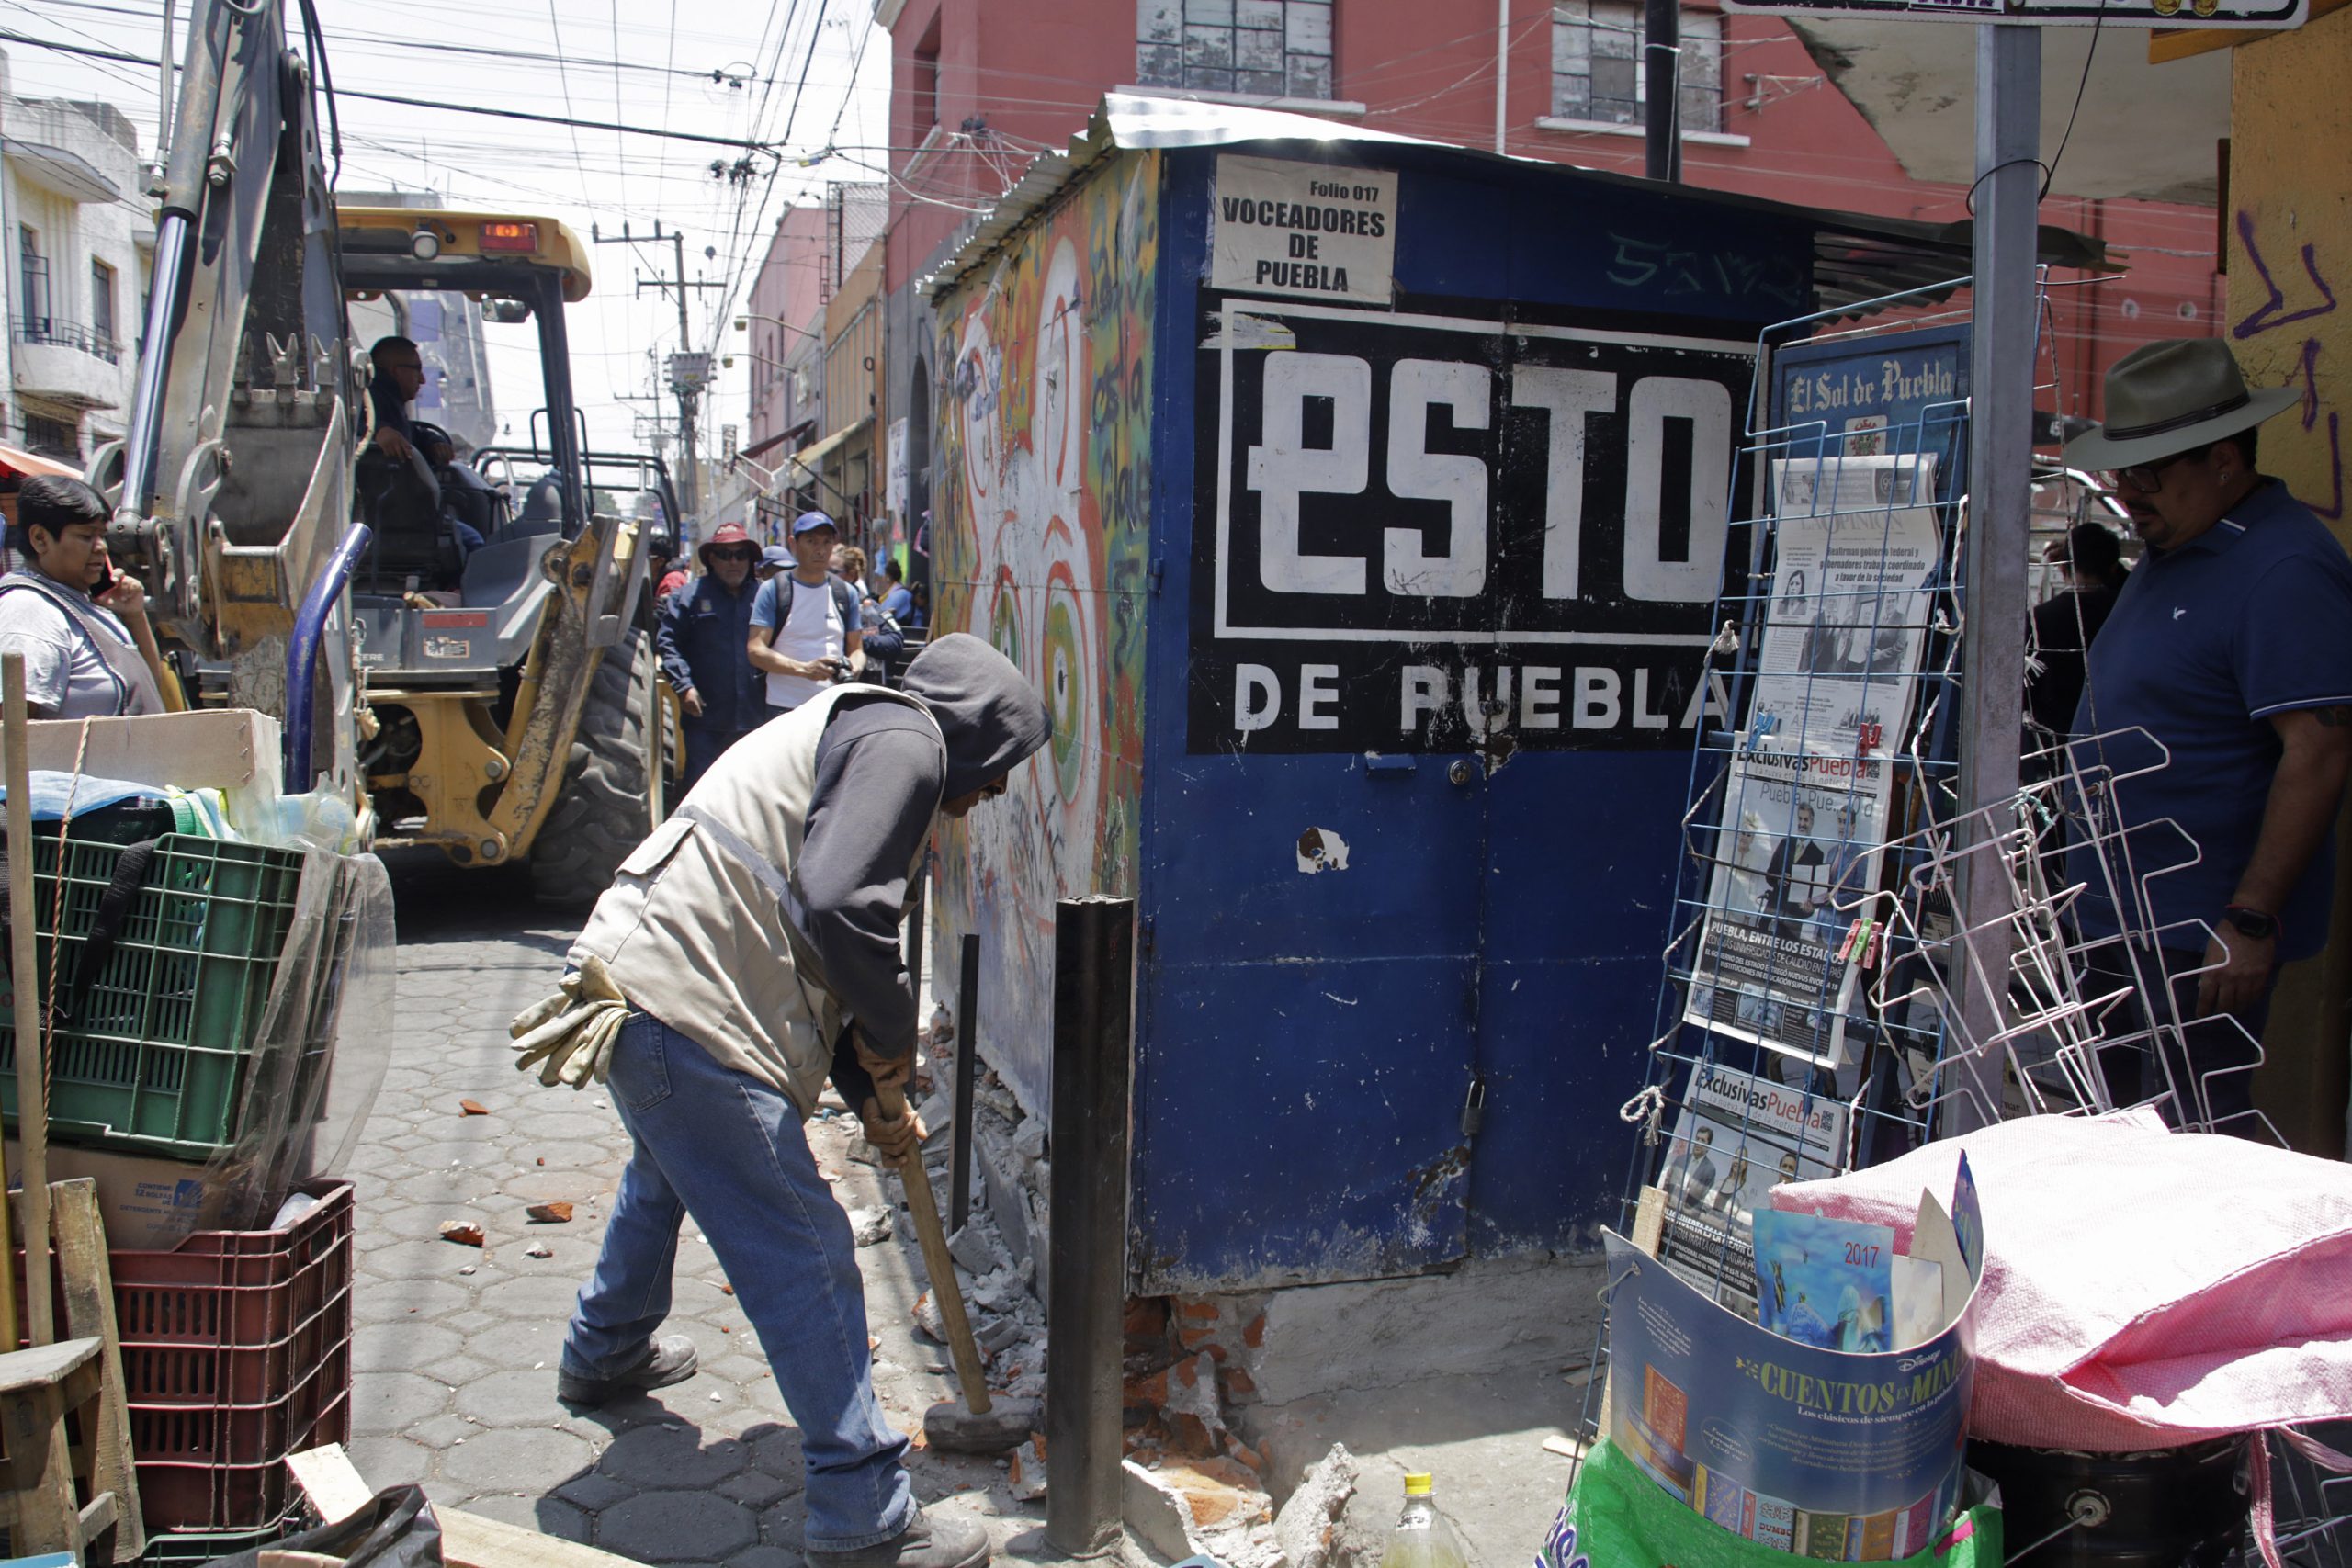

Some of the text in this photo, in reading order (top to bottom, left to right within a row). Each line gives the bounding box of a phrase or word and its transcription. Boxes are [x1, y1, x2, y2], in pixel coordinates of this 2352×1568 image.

[1310, 181, 1379, 202] Folio 017
[1223, 197, 1385, 237] VOCEADORES
[1289, 233, 1318, 260] DE
[1256, 260, 1348, 292] PUEBLA
[1792, 359, 1953, 412] El Sol de Puebla
[1820, 559, 1925, 570] gbernadores trabao coordinado
[1860, 547, 1889, 558] gobiero
[1873, 573, 1904, 583] sciedad
[1234, 663, 1732, 732] DE PUEBLA
[1711, 921, 1747, 942] PUEBLA,
[1749, 931, 1780, 949] ENTRE
[1781, 939, 1800, 953] LOS
[1845, 1242, 1879, 1269] 2017
[1896, 1349, 1941, 1372] Disney
[1760, 1361, 1895, 1415] CUENTOS
[1798, 1405, 1816, 1418] Los
[1817, 1409, 1859, 1424] clásicos
[1860, 1415, 1873, 1425] de
[1874, 1409, 1915, 1425] siempre
